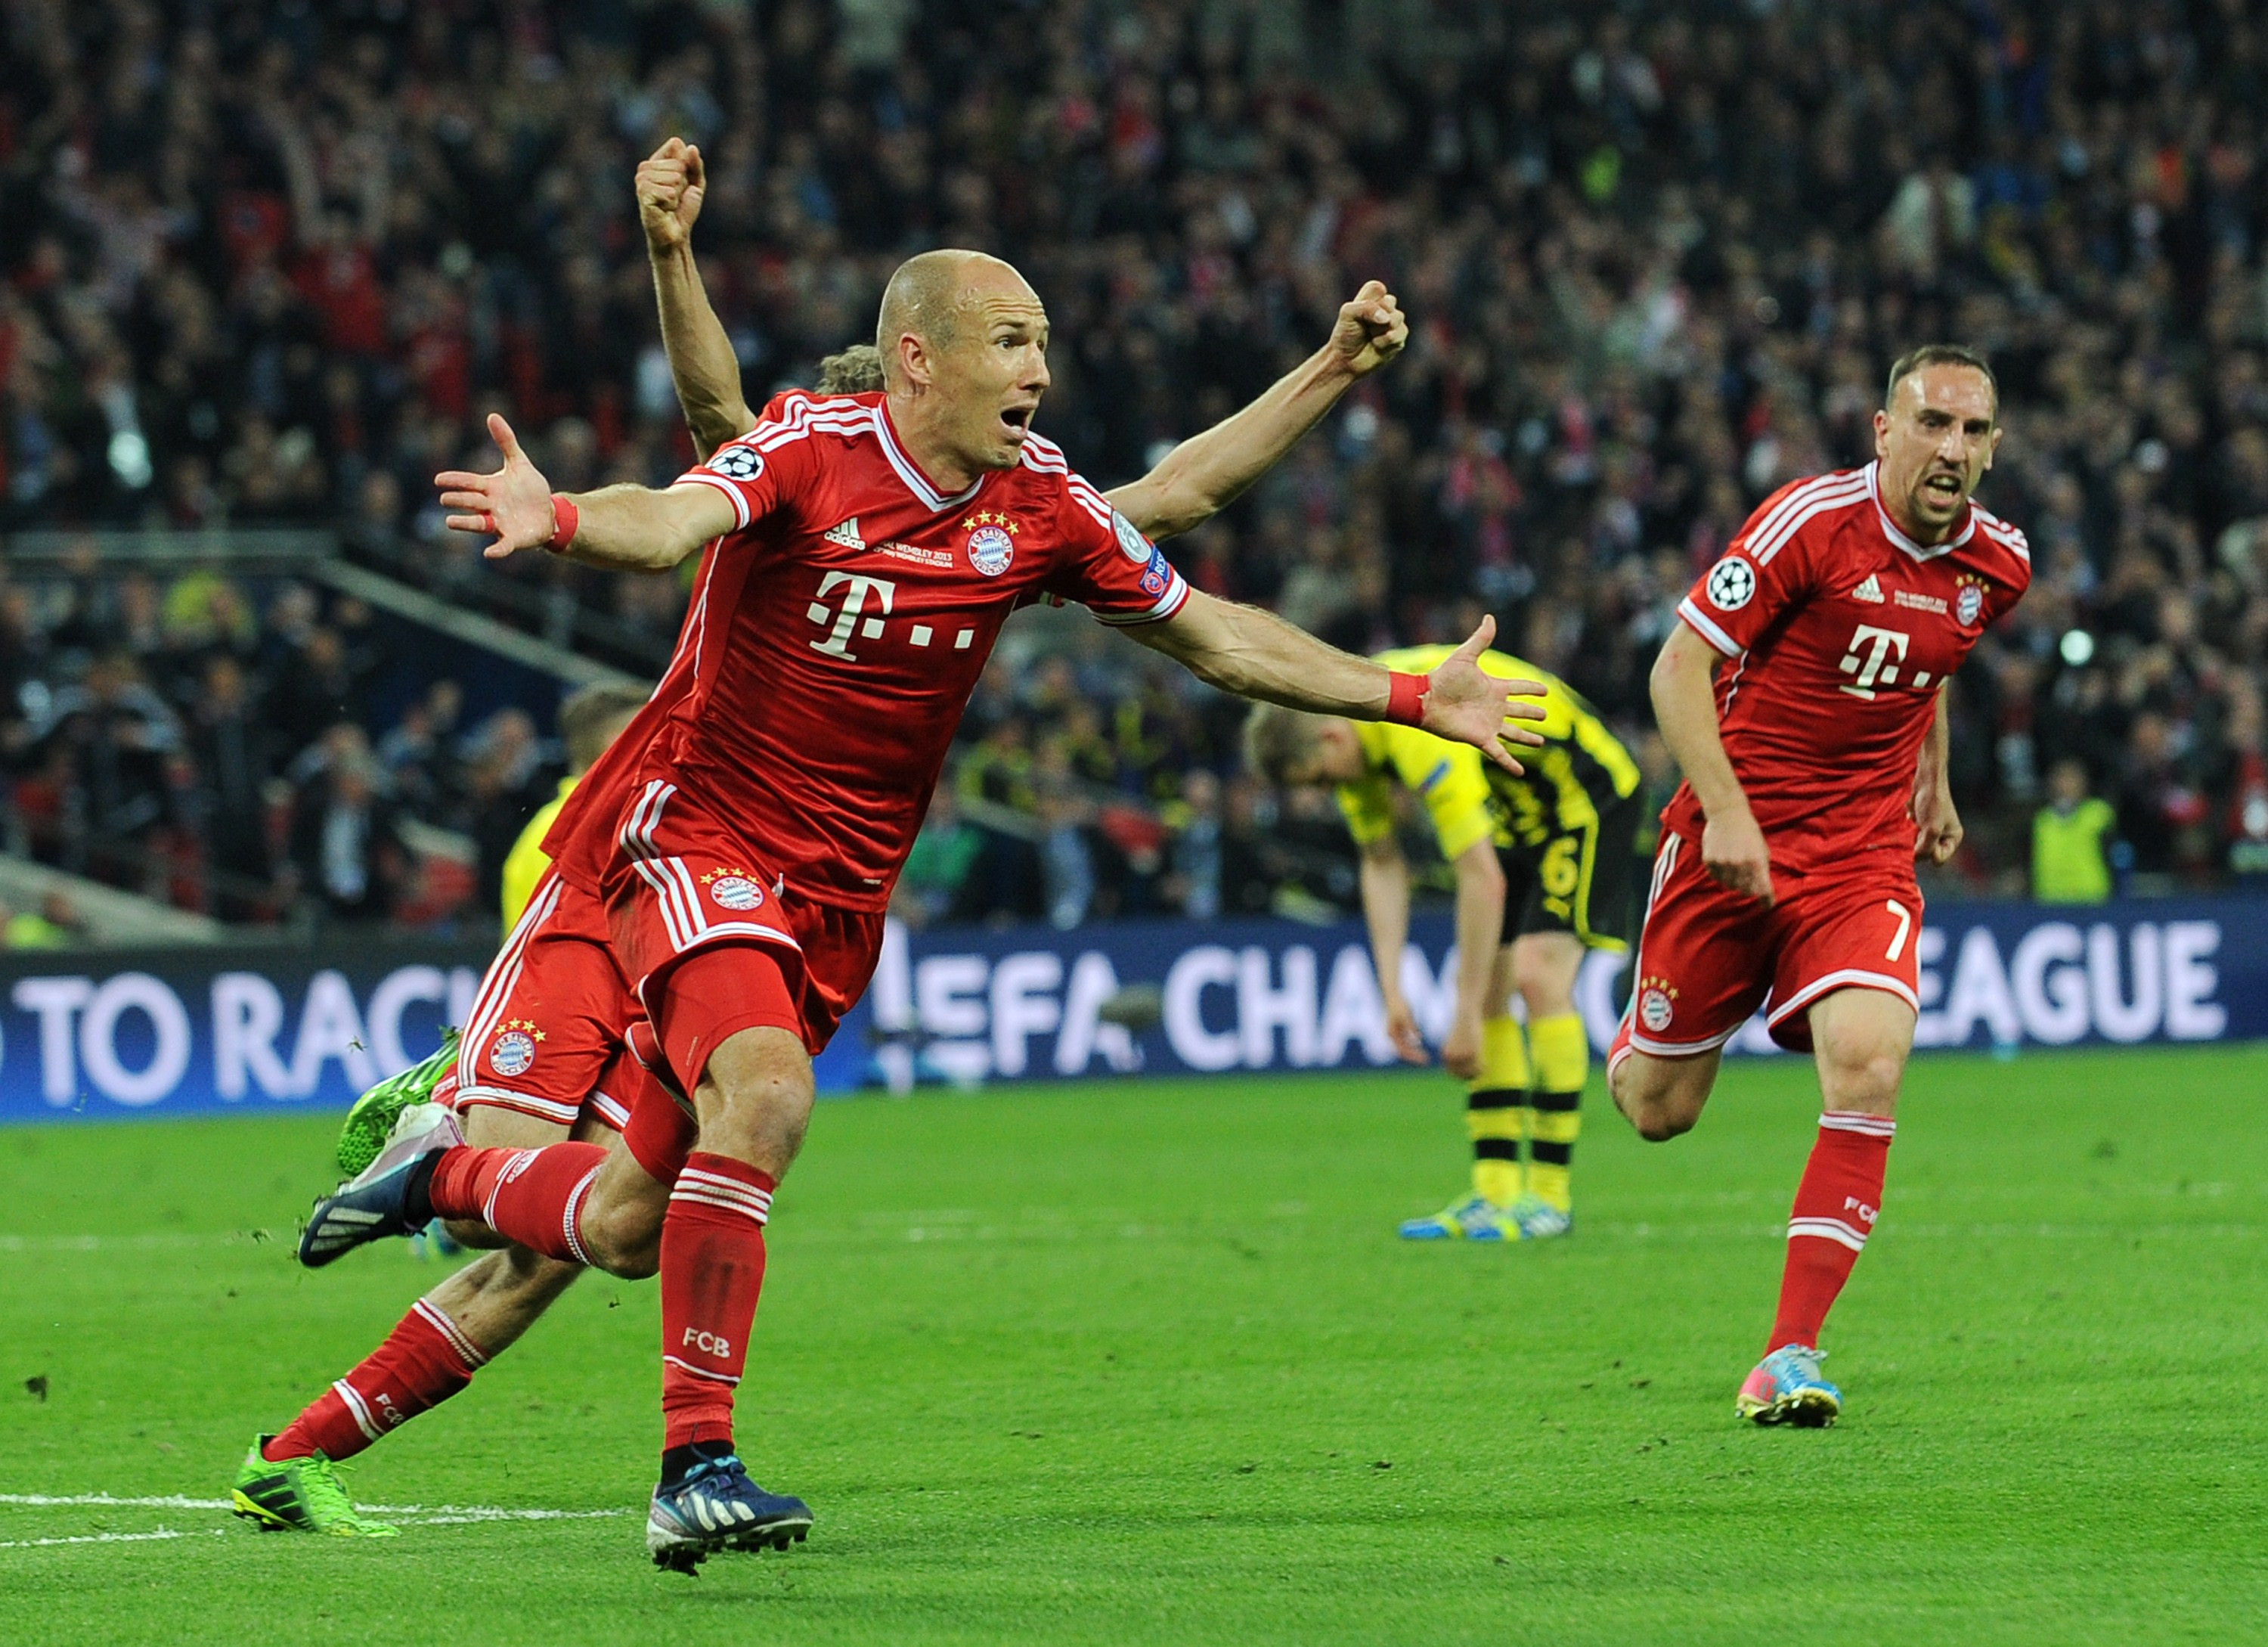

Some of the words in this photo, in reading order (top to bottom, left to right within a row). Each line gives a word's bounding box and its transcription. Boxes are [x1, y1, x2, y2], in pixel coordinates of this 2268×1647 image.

[824, 531, 866, 551] adidas
[1154, 551, 1166, 576] RES
[1541, 837, 1578, 897] 6
[1885, 898, 1911, 963] 7
[12, 971, 192, 1107] TO
[1913, 920, 2231, 1048] EAGUE
[682, 1326, 731, 1359] FCB
[375, 1392, 404, 1425] FCB
